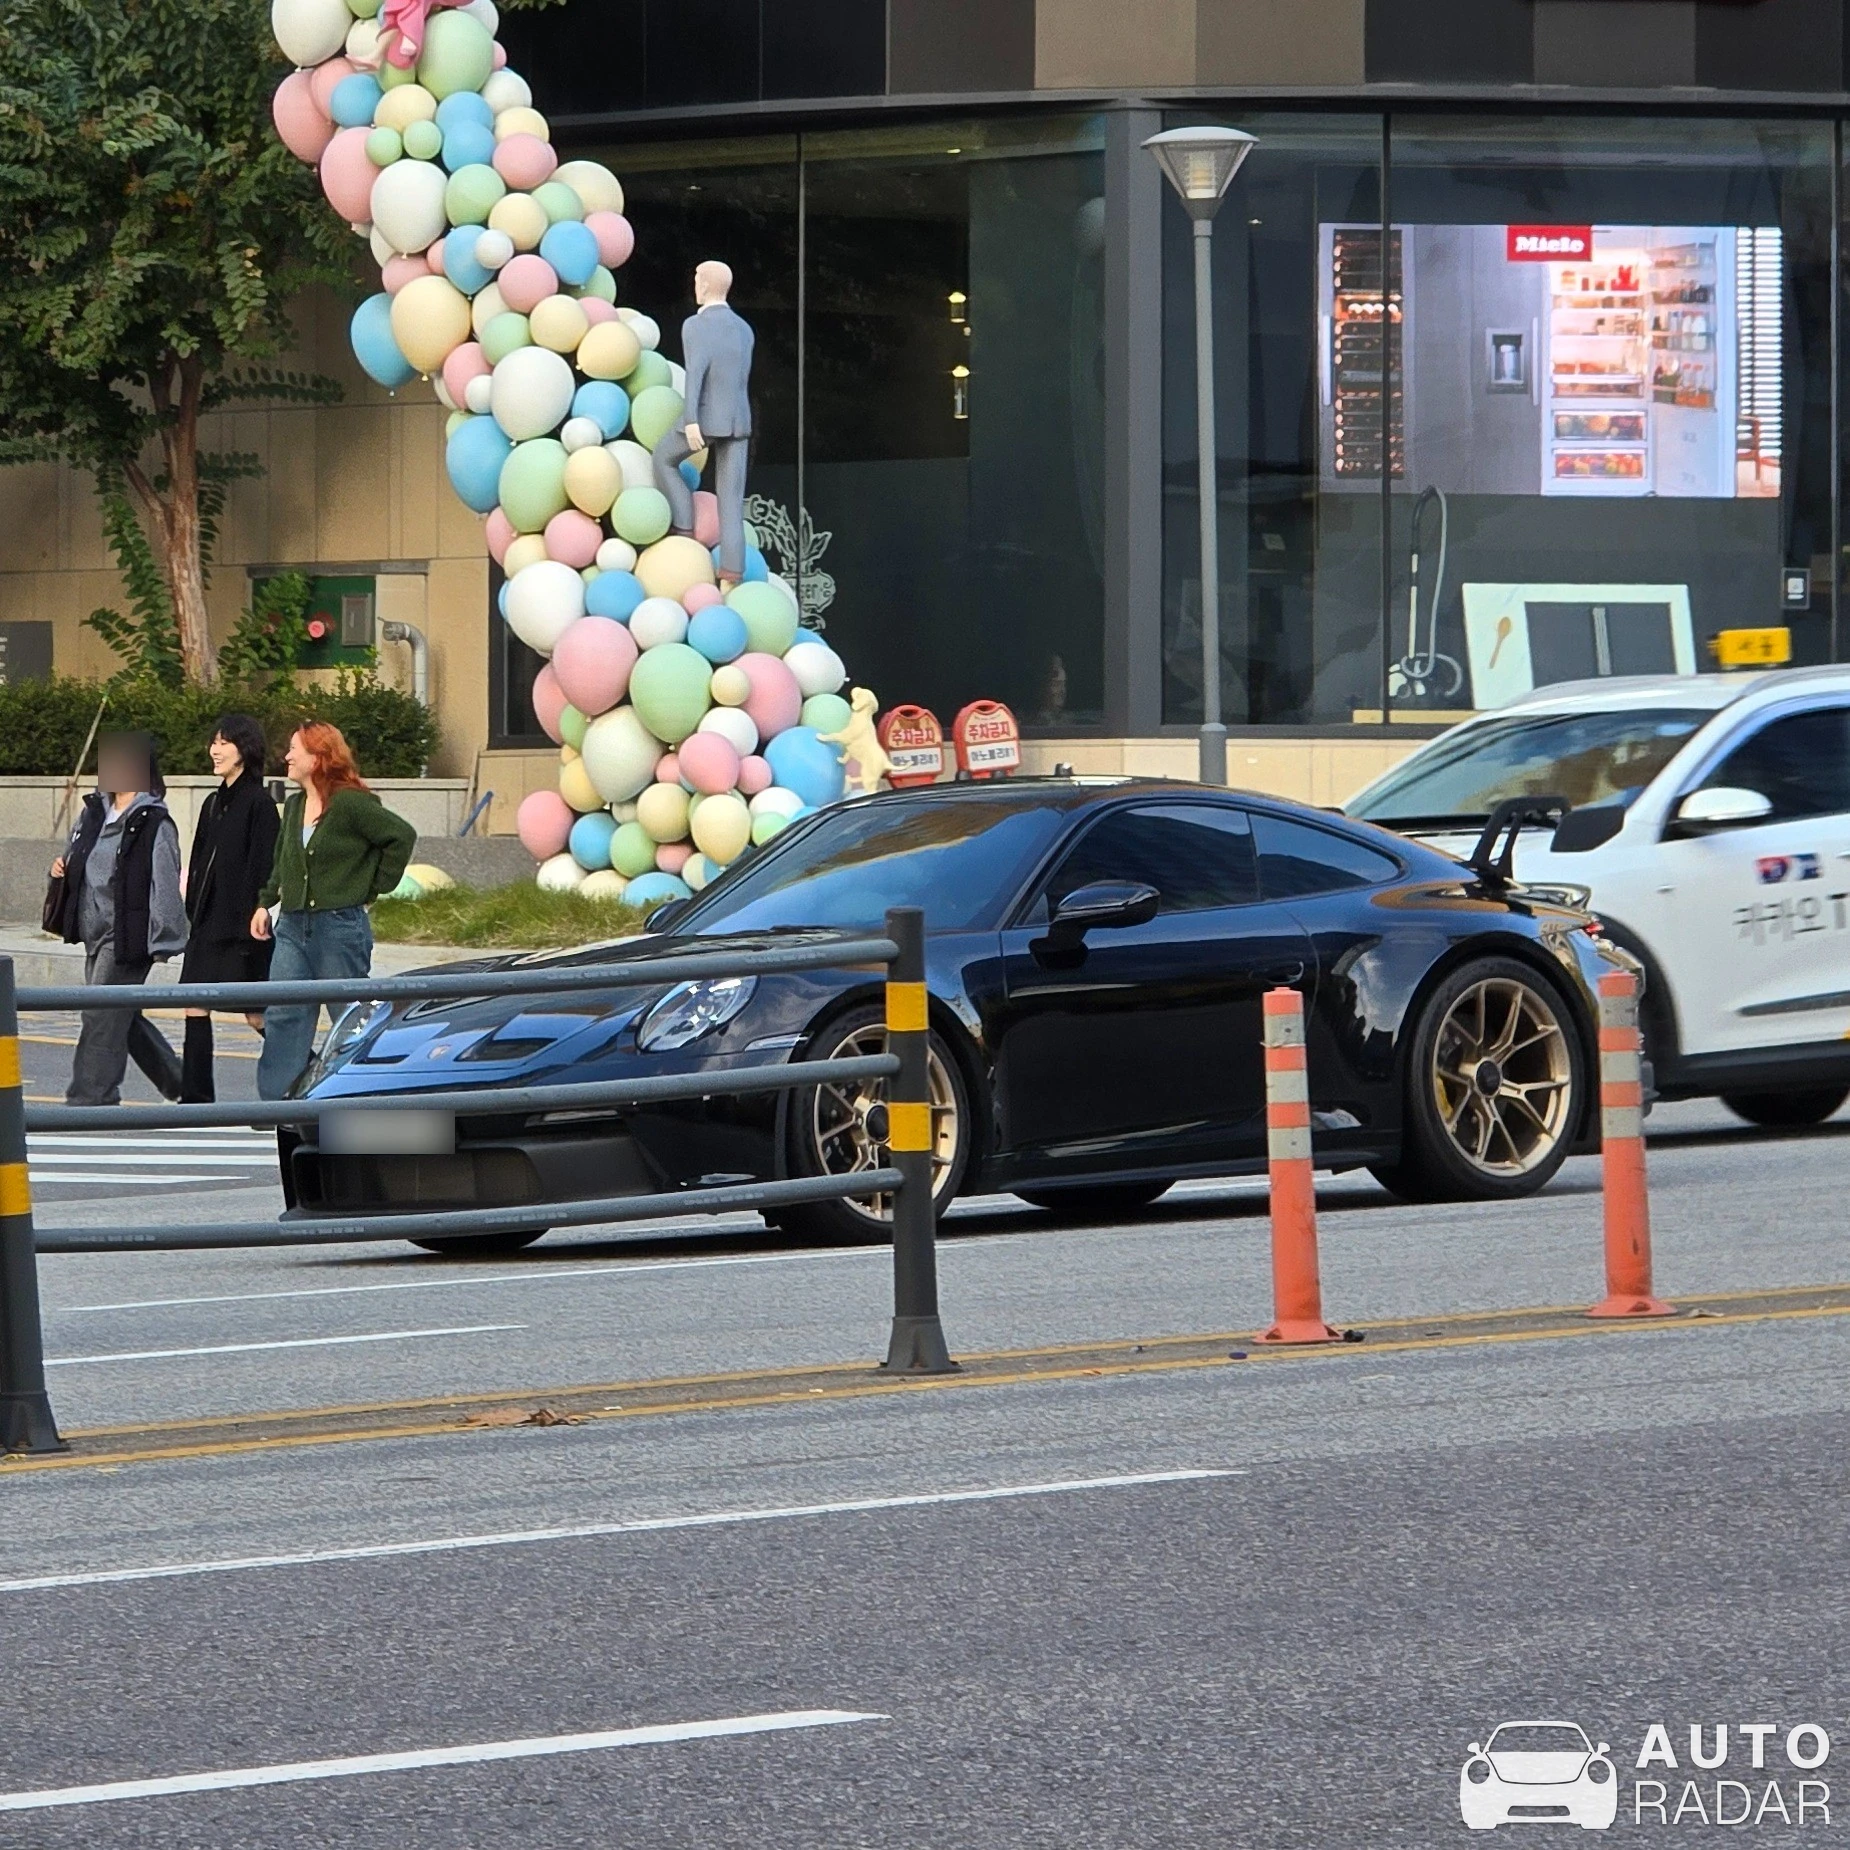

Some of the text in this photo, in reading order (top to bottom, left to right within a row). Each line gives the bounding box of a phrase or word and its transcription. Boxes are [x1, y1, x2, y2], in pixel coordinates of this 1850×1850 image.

[1515, 235, 1585, 254] Miele
[891, 727, 936, 746] 주차금지
[968, 720, 1011, 741] 주차금지
